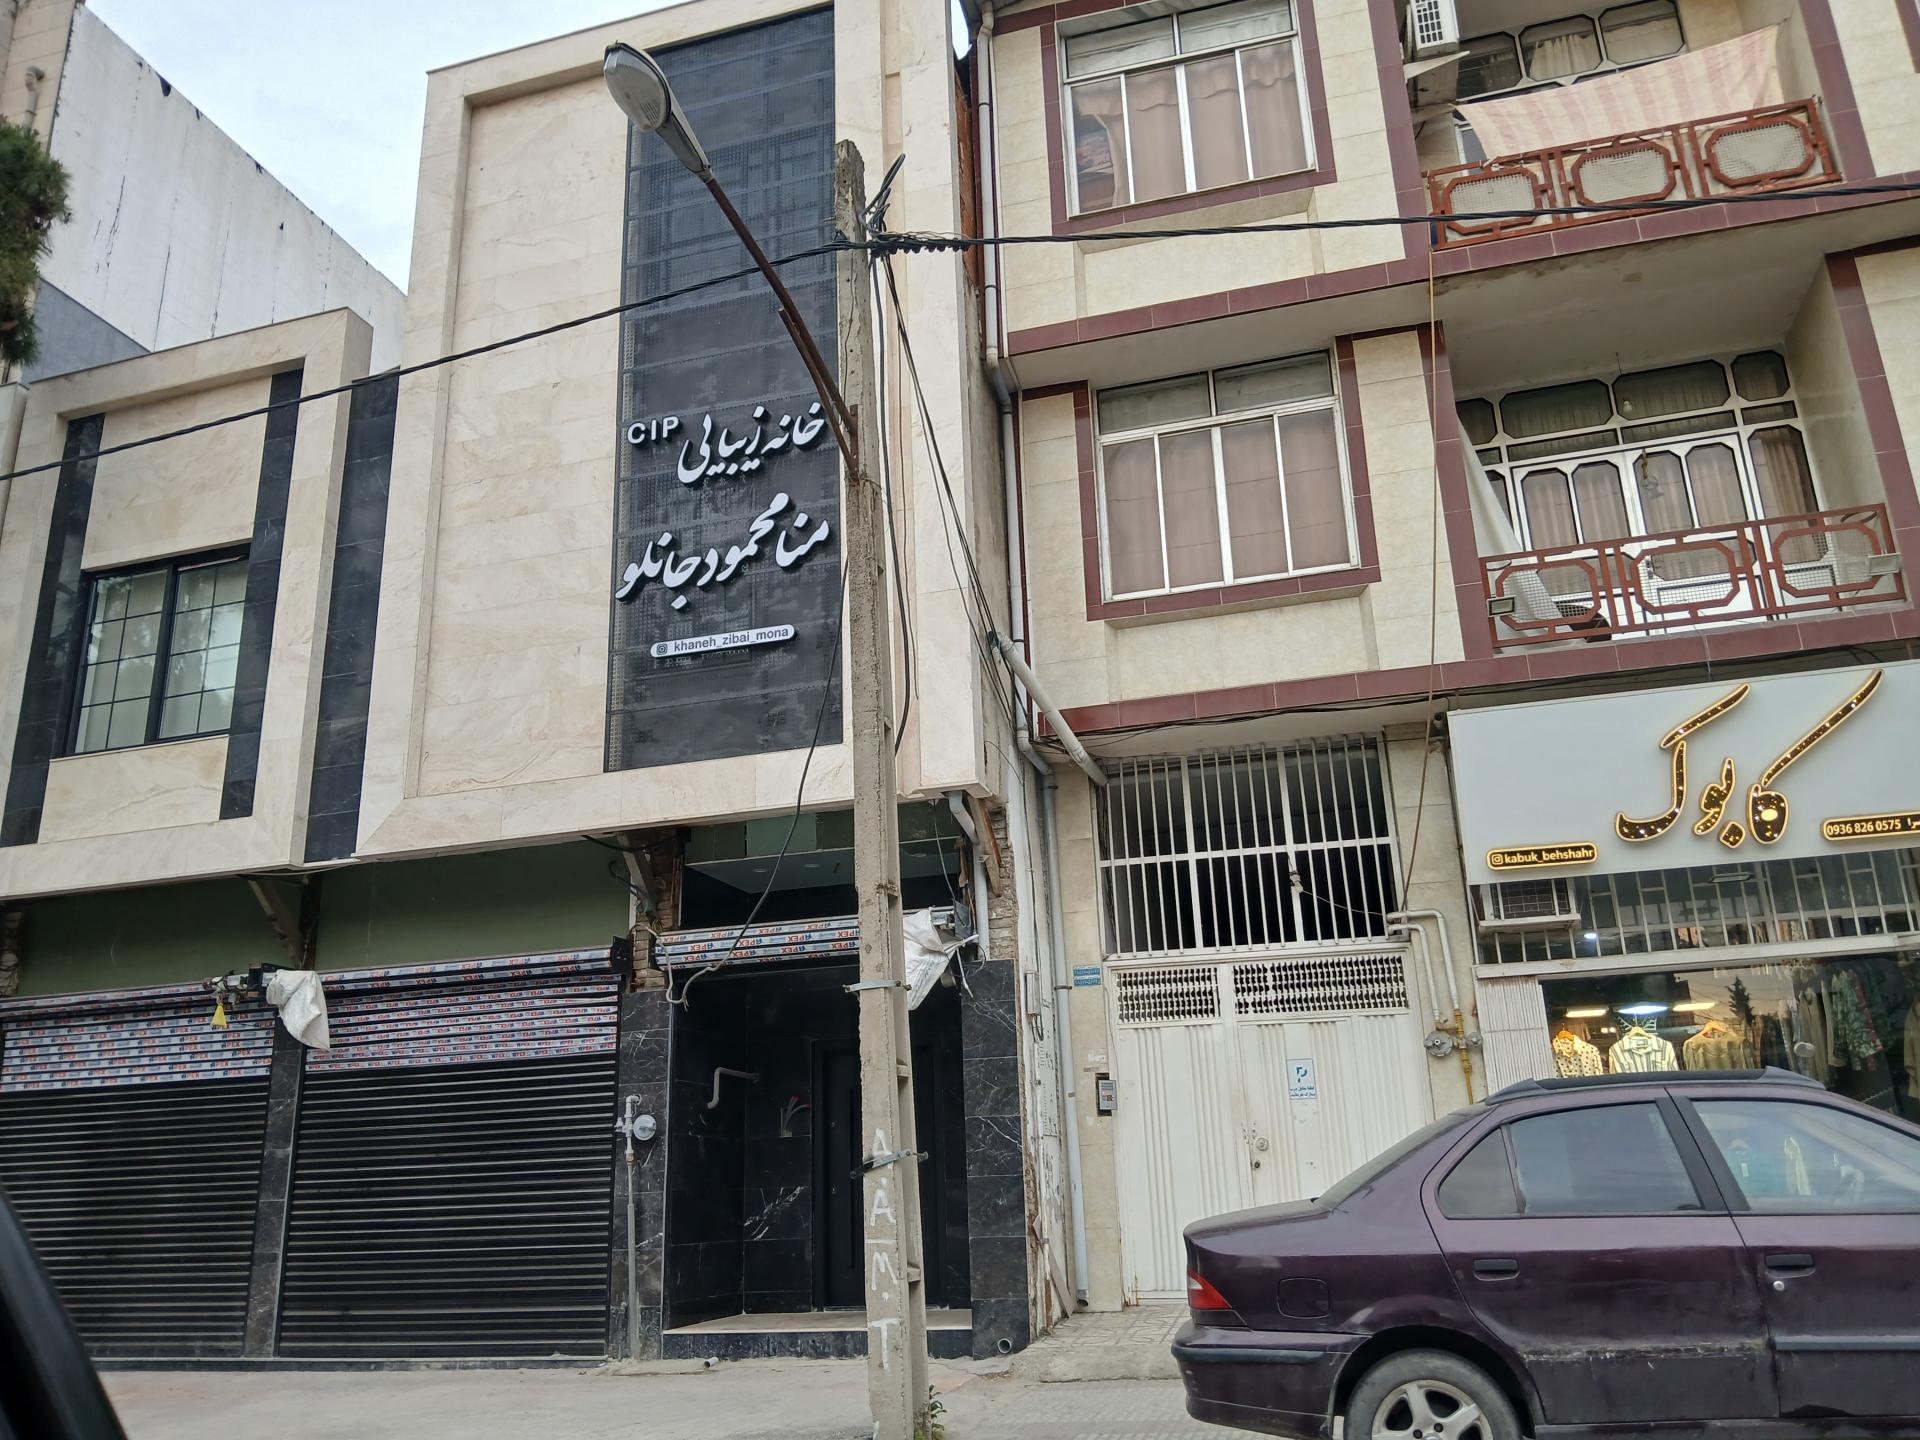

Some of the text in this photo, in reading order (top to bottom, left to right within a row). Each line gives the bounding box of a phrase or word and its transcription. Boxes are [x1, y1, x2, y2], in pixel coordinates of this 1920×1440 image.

[627, 416, 679, 444] CIP
[761, 401, 825, 454] خانه
[775, 512, 829, 567] منا
[673, 627, 789, 652] khaneh_zibai_mona
[1827, 820, 1902, 836] 0936 826 0575
[1504, 847, 1595, 865] kabuk_behshahr
[683, 954, 707, 962] APEX
[732, 949, 756, 958] APEX
[781, 945, 805, 954] APEX
[831, 940, 856, 949] APEX
[689, 942, 713, 951] APEX
[737, 938, 762, 947] APEX
[787, 933, 812, 942] APEX
